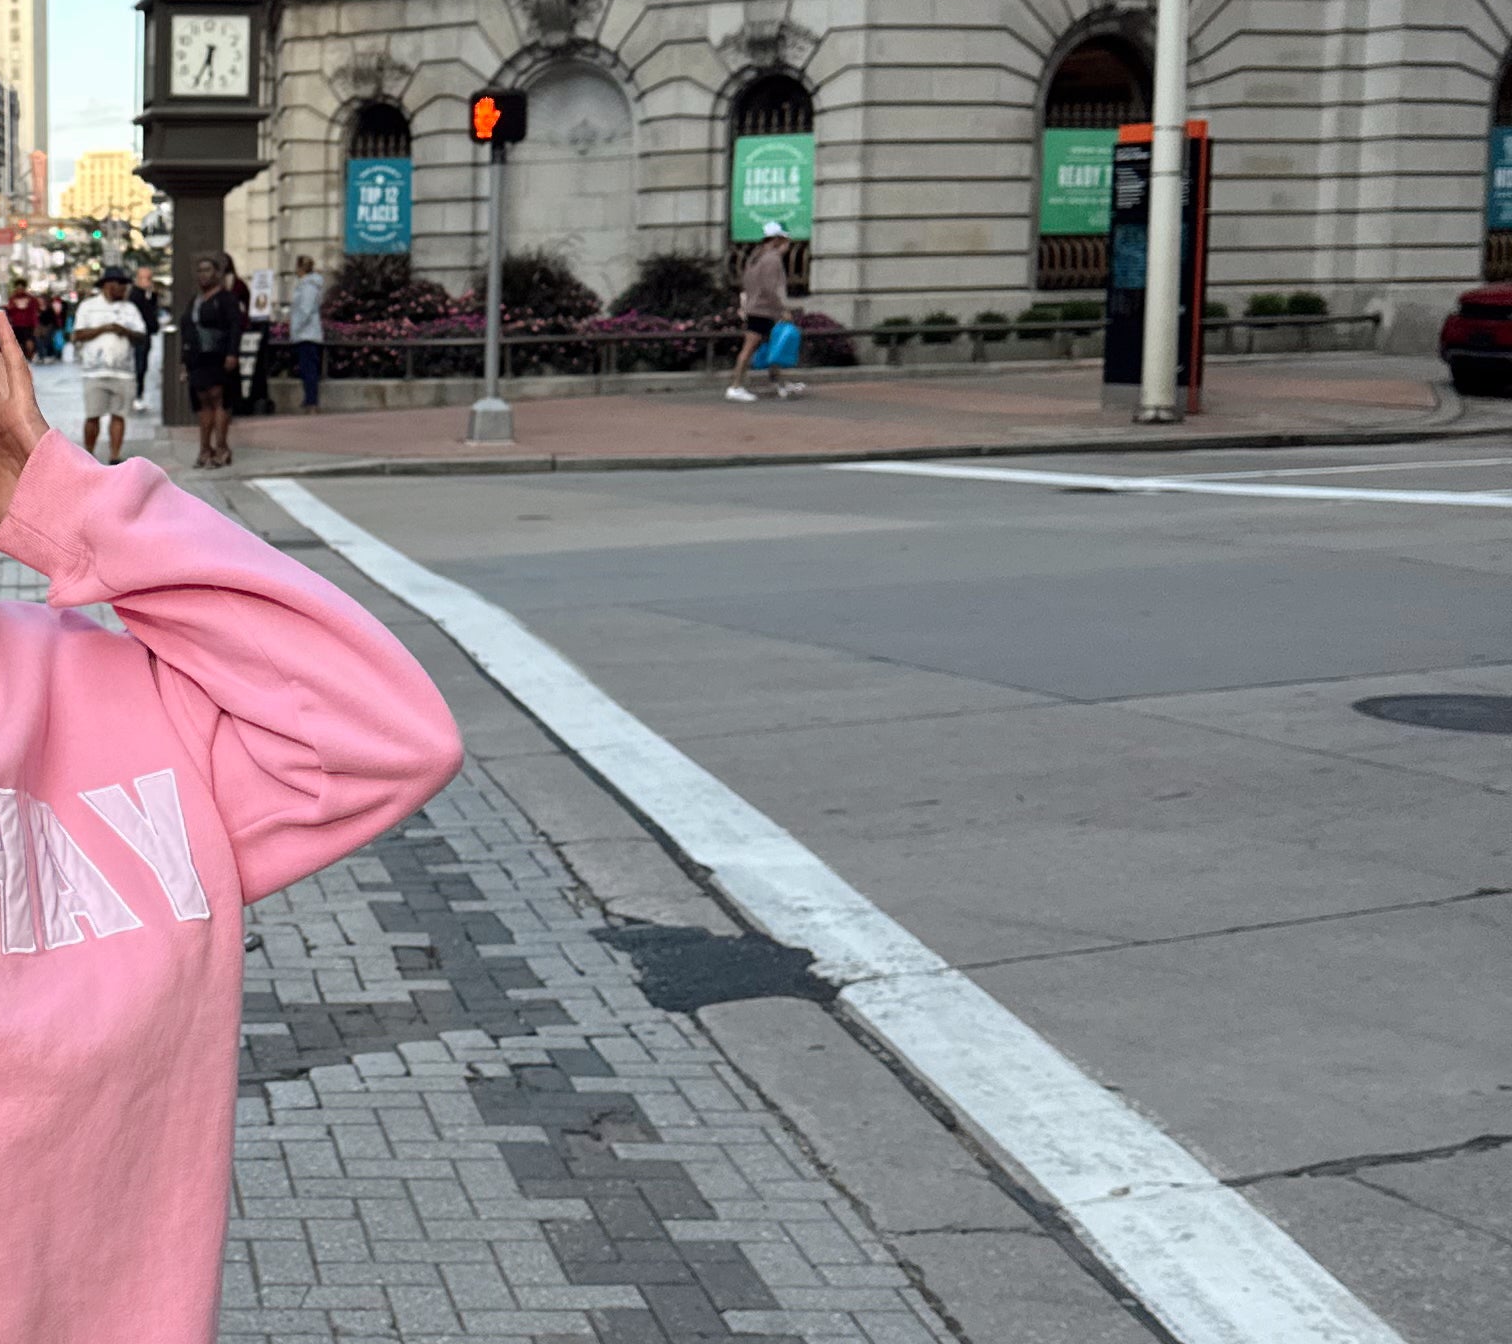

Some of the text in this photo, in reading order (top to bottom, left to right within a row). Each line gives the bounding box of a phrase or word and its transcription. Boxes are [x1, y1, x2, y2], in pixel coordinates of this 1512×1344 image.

[745, 167, 786, 185] LOCAL
[1058, 164, 1101, 187] READY
[360, 186, 399, 204] TOP 12
[743, 187, 801, 206] ORGANIC
[356, 205, 400, 222] PLACES
